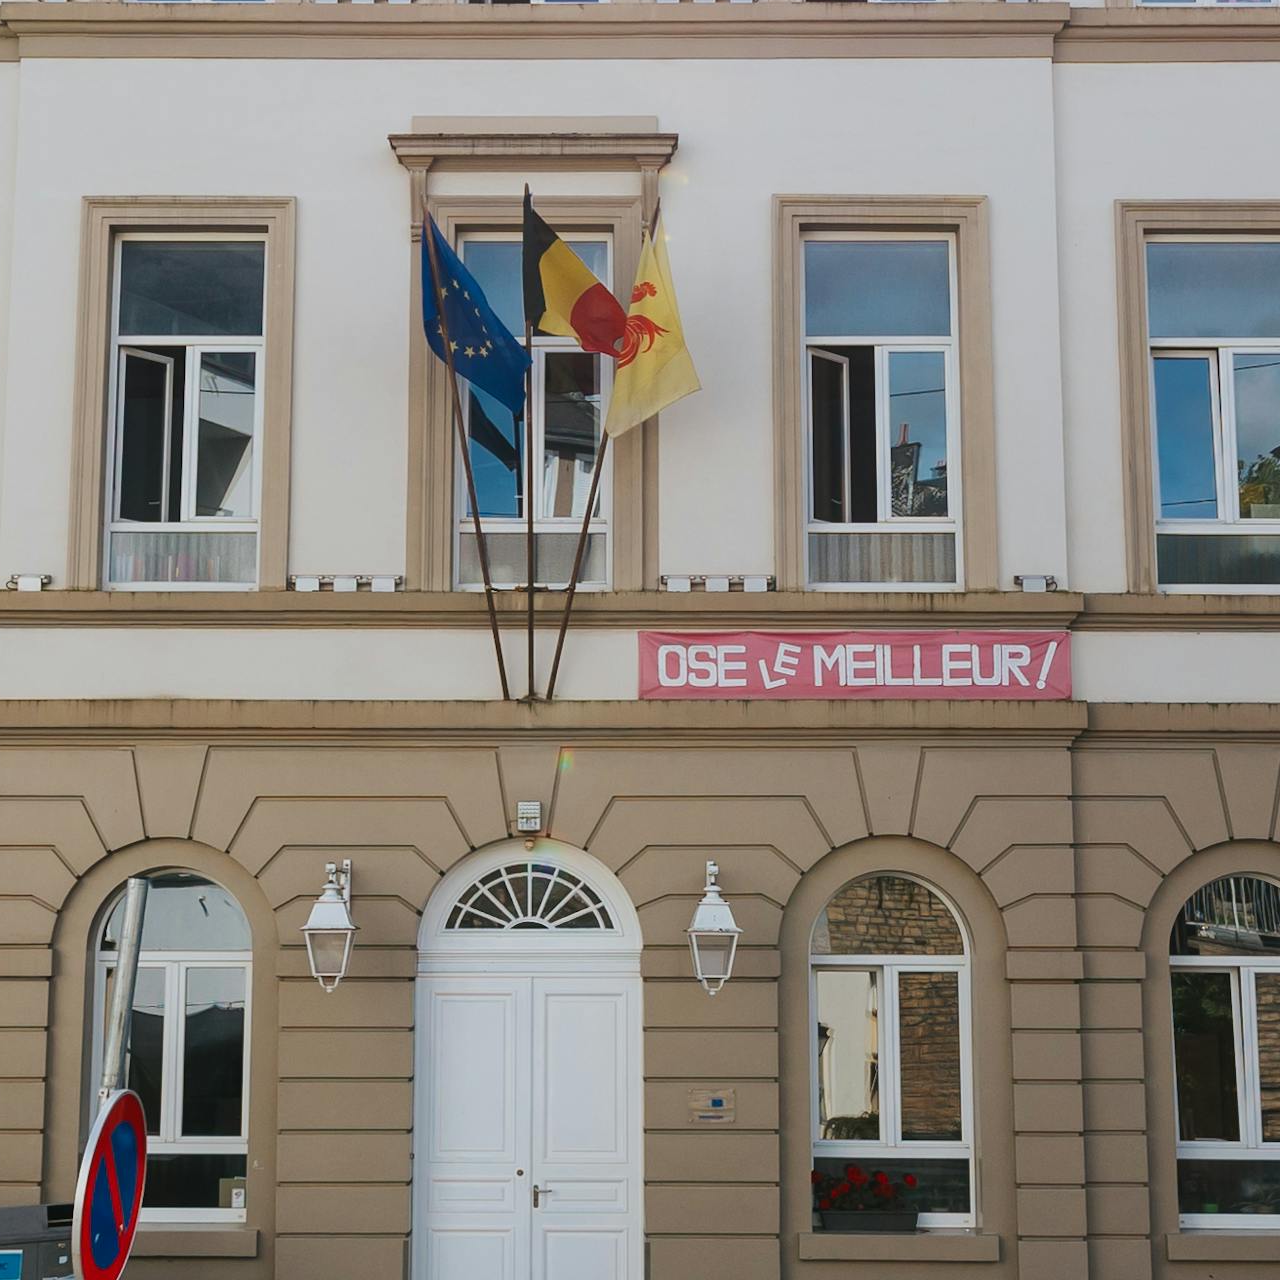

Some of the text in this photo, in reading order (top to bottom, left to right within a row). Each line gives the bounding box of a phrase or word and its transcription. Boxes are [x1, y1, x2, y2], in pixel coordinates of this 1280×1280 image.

[657, 641, 1057, 690] OSE LE MEILLEUR!
